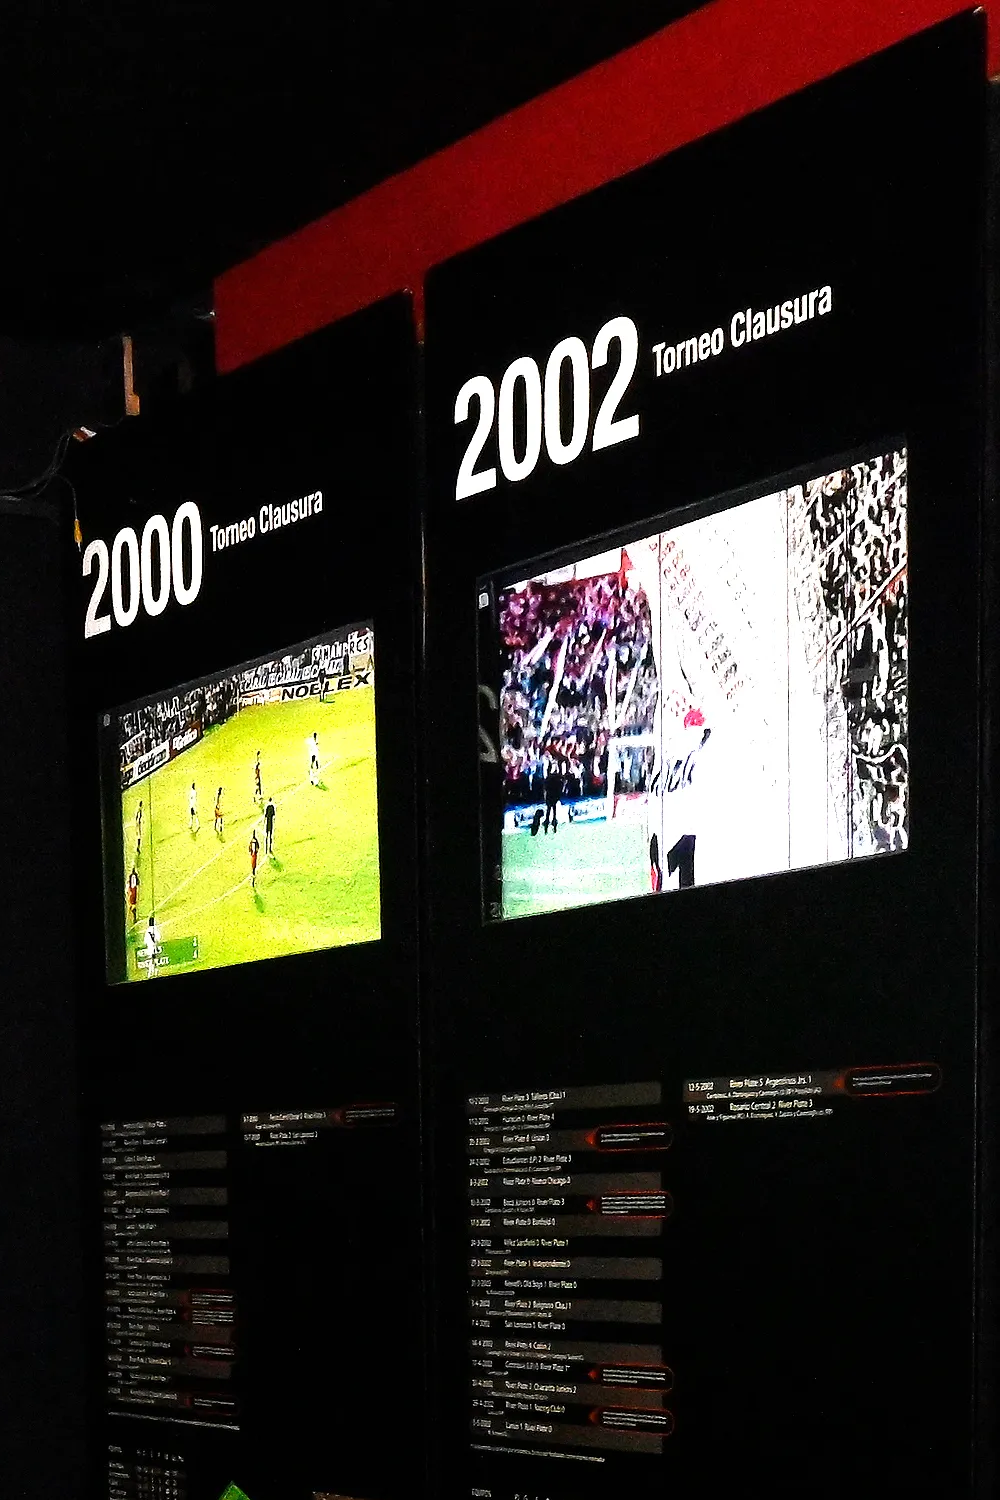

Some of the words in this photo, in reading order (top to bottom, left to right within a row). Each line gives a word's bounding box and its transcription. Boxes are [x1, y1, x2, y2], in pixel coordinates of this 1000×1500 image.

[651, 326, 725, 378] Torneo
[729, 284, 833, 347] Clausura
[453, 316, 640, 501] 2002
[82, 501, 203, 640] 2000
[209, 516, 256, 552] Torneo
[259, 490, 323, 534] Clausura
